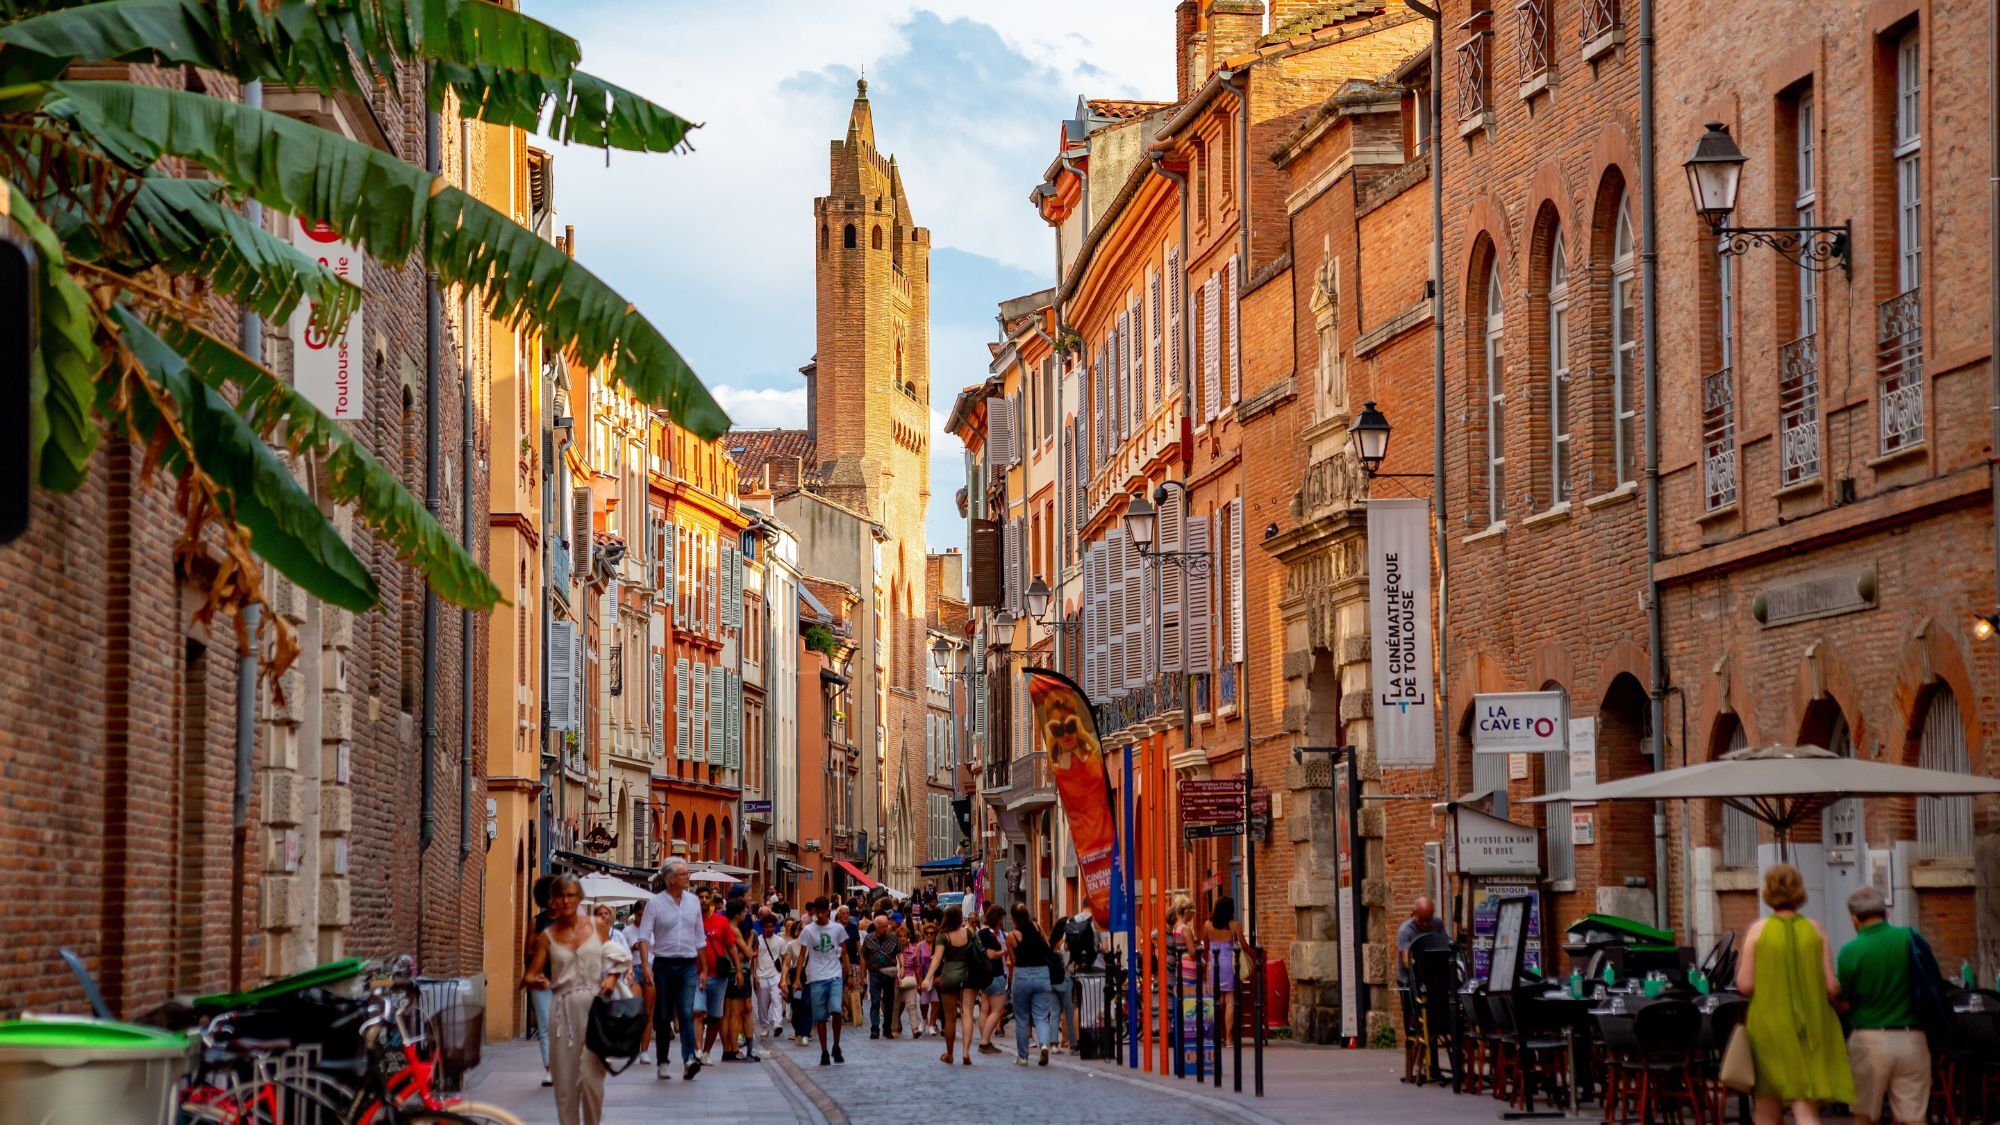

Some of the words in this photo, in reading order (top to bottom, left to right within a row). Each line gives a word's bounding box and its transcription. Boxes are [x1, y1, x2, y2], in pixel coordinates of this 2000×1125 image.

[1384, 552, 1401, 674] CINÉMATHÈQUE
[1402, 590, 1416, 673] TOULOUSE
[1390, 677, 1402, 697] LA
[1404, 677, 1417, 697] DE
[1488, 705, 1508, 718] LA
[1480, 718, 1521, 731] CAVE
[1461, 836, 1471, 845] LA
[1474, 836, 1503, 845] POESIE
[1505, 836, 1514, 845] EN
[1517, 836, 1535, 844] GANT
[1483, 847, 1493, 855] DE
[1495, 847, 1514, 855] BOXE
